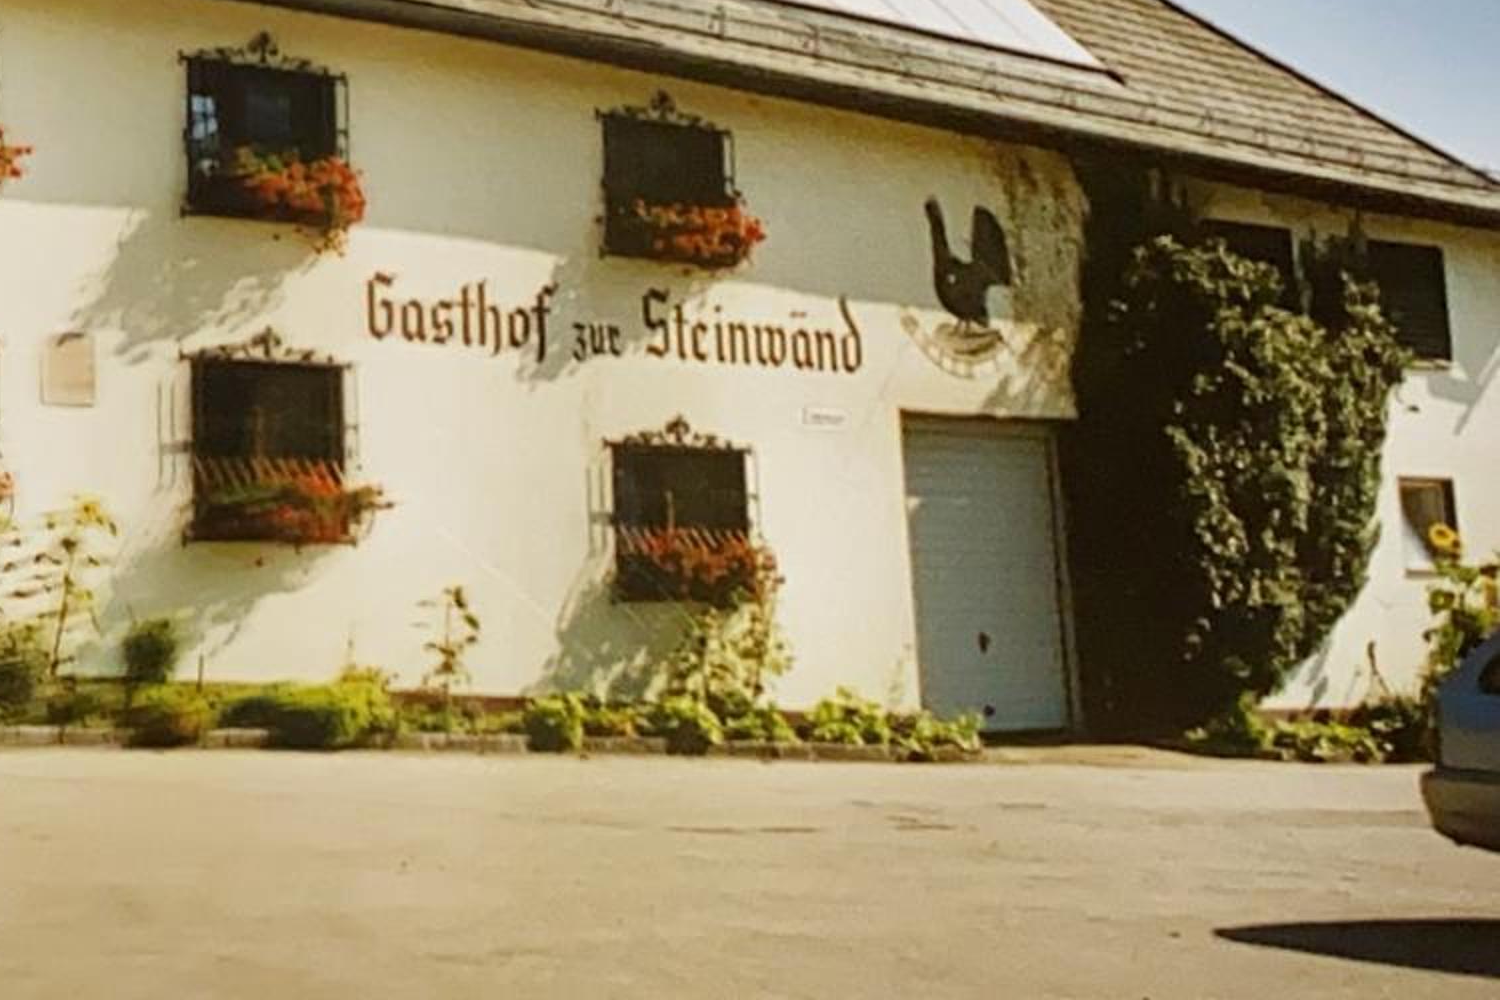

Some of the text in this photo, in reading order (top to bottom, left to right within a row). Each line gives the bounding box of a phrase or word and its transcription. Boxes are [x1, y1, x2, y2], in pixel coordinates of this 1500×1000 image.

[366, 271, 864, 374] Gasthof zur Steinwänd
